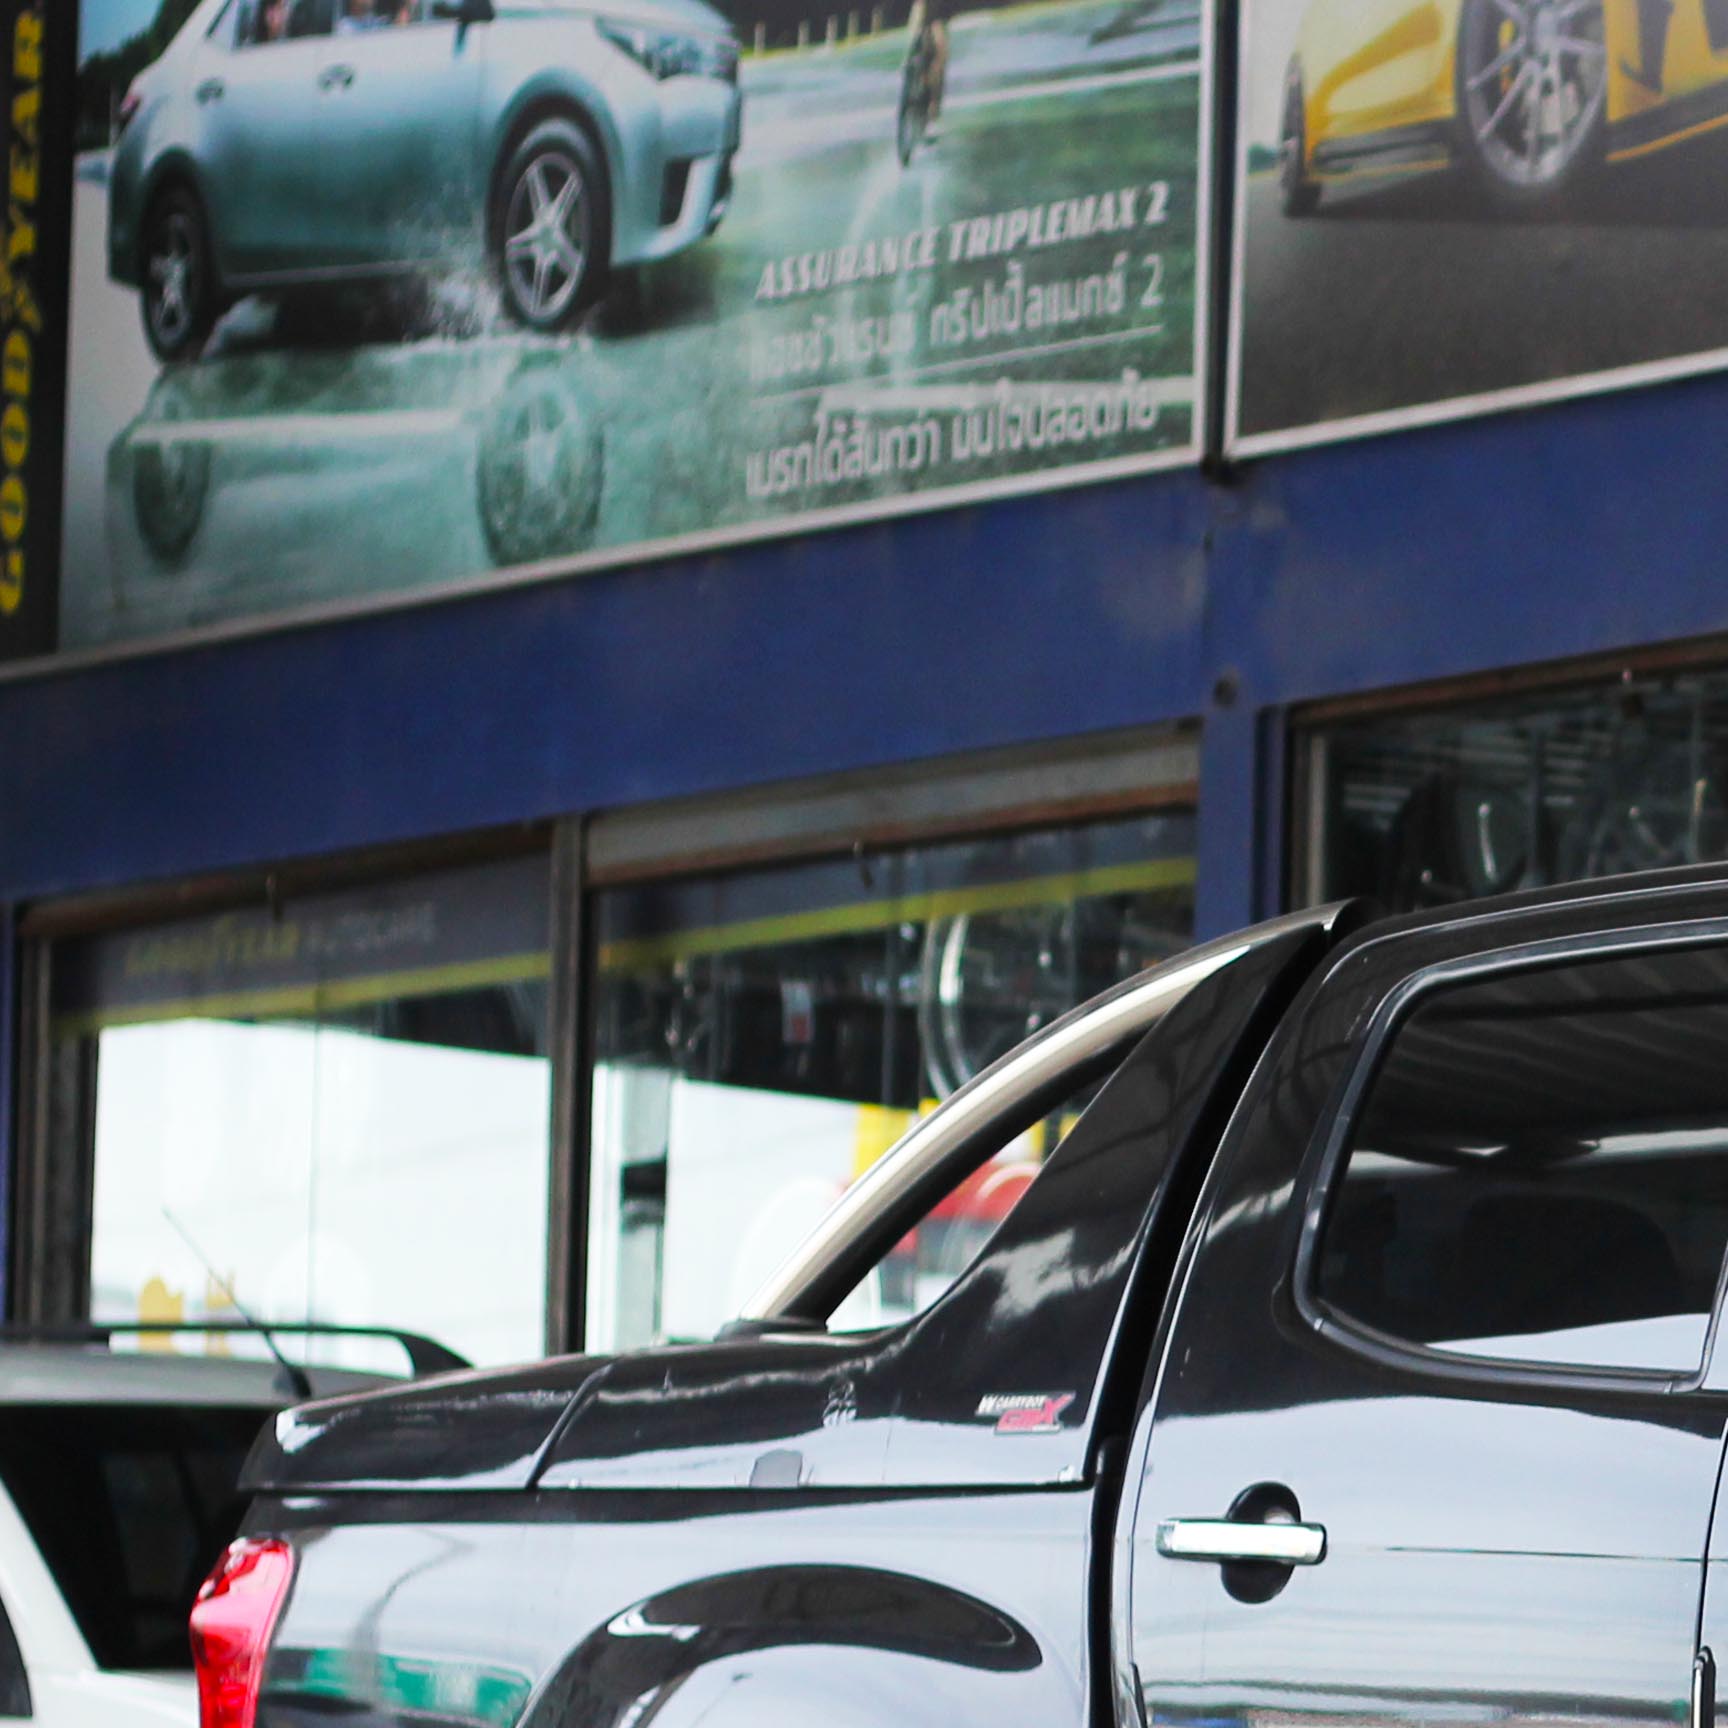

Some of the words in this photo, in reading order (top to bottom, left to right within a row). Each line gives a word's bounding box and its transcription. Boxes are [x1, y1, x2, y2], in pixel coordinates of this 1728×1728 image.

[755, 226, 941, 299] ASSURANCE
[947, 187, 1136, 262] TRIPLEMAX
[1144, 180, 1170, 225] 2
[1140, 253, 1166, 309] 2
